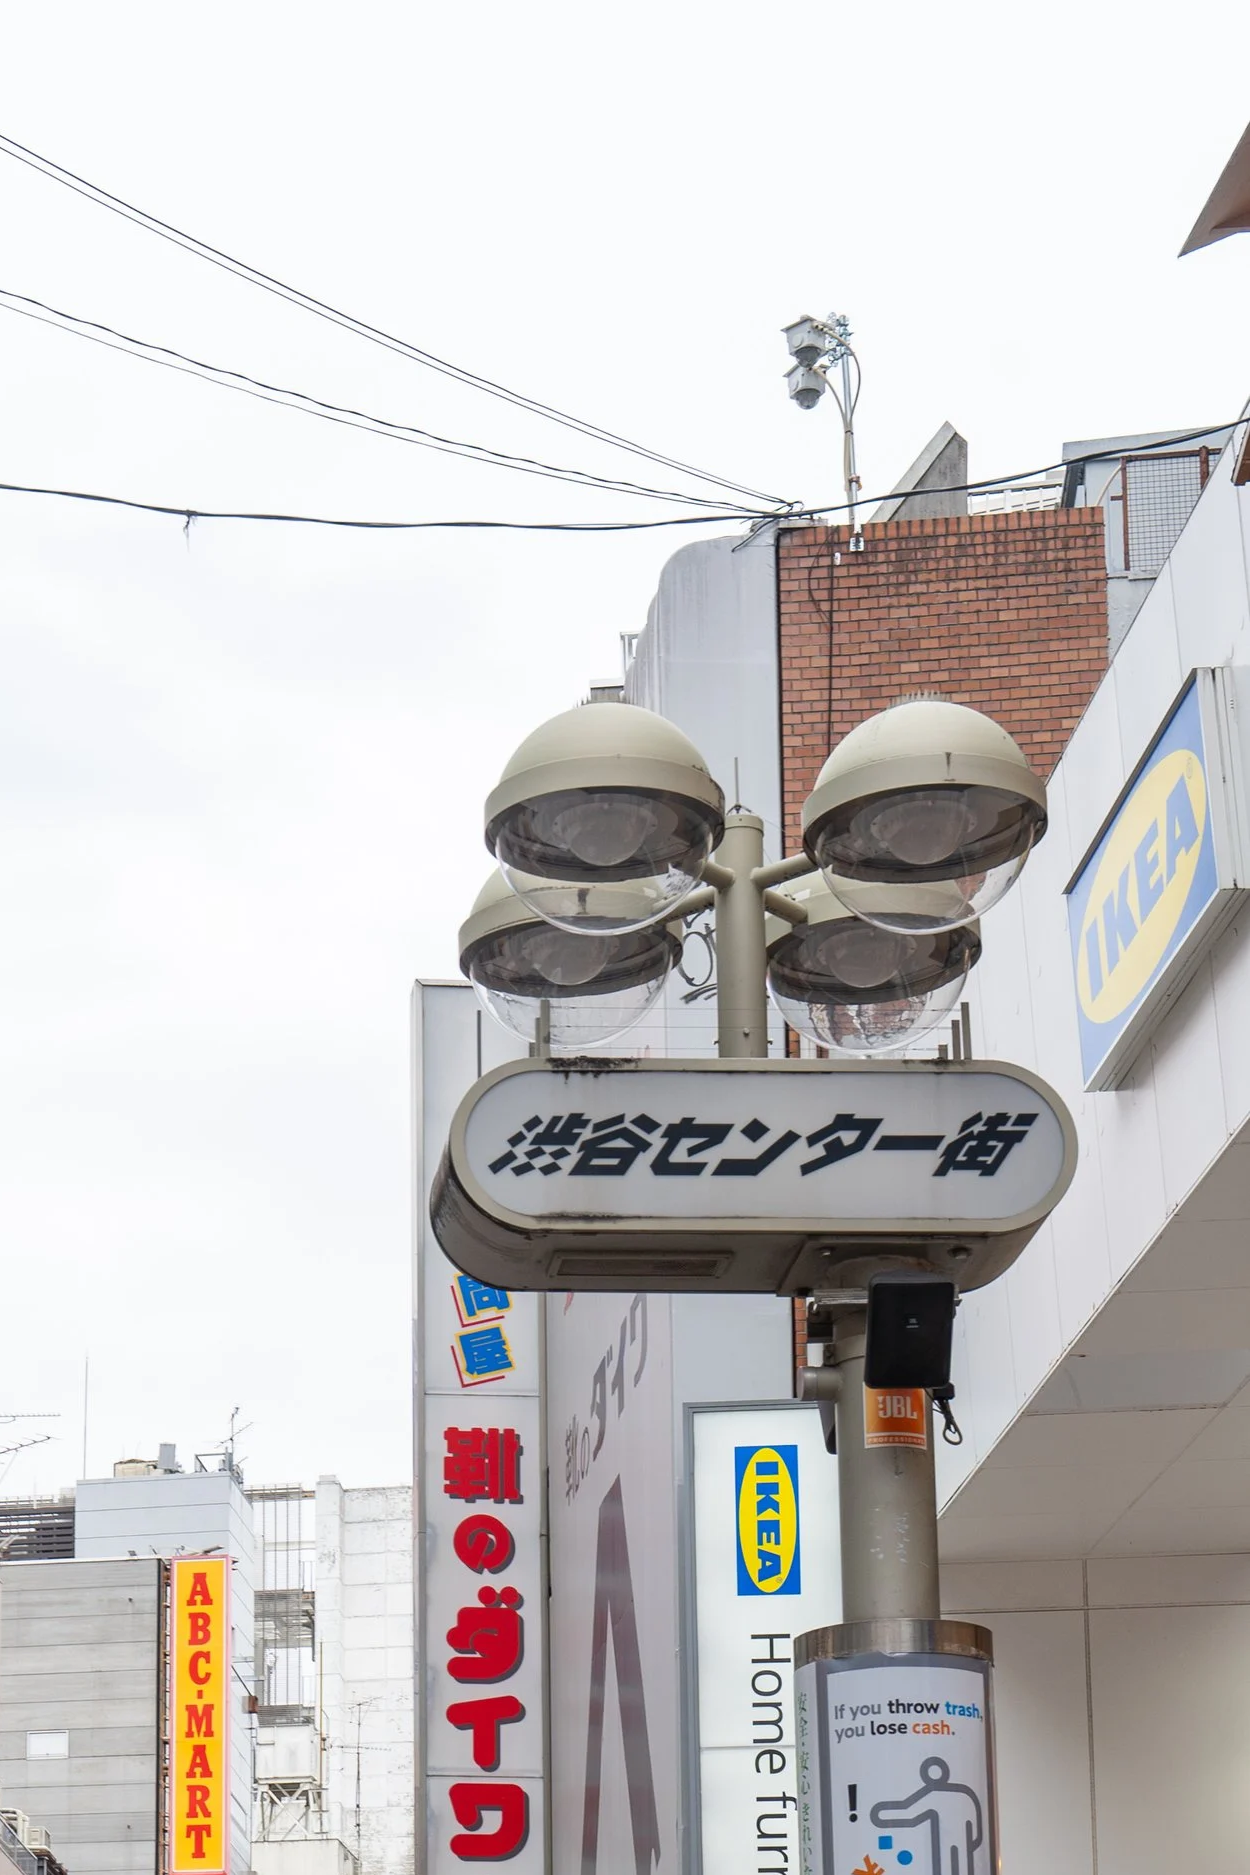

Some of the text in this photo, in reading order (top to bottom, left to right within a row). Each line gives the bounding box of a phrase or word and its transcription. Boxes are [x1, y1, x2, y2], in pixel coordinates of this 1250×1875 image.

[1086, 773, 1199, 1002] IKEA
[489, 1113, 1039, 1178] 渋谷センター街
[877, 1395, 918, 1420] JBL
[755, 1460, 782, 1583] IKEA
[442, 1426, 529, 1860] 靴のダイワ
[750, 1633, 791, 1775] Home
[834, 1698, 984, 1721] If you throw trash,
[835, 1720, 956, 1744] you lose cash.
